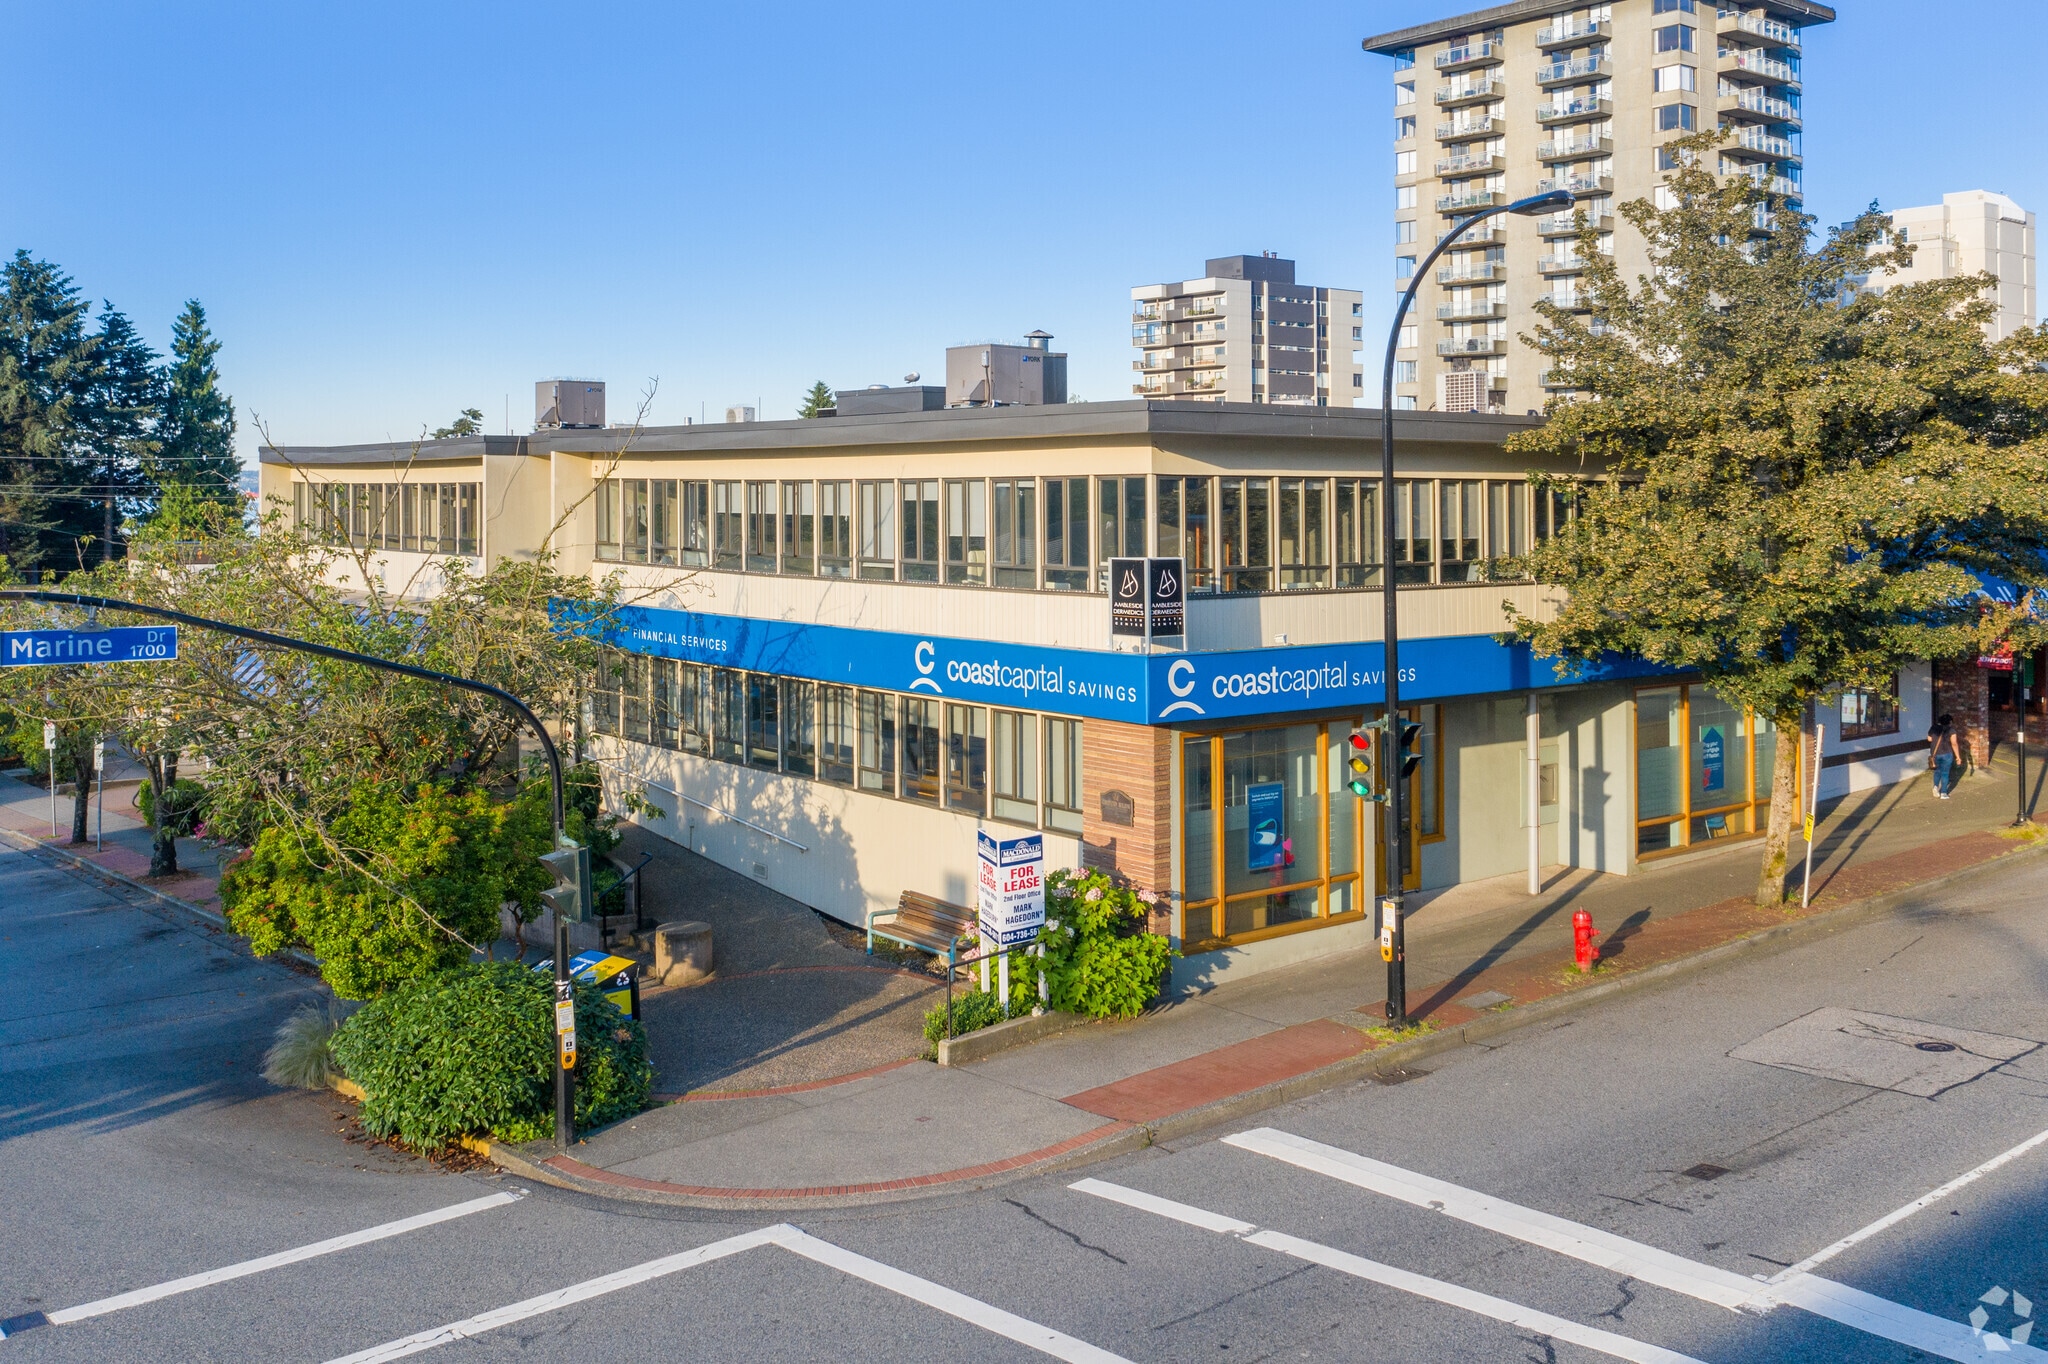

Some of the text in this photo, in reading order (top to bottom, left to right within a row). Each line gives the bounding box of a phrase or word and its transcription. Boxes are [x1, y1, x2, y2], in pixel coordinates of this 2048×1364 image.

[11, 631, 166, 659] Marine Dr
[633, 629, 727, 651] FINANCIAL SERVICES
[130, 644, 167, 657] 1700
[947, 660, 1137, 703] coastcapital SAVINGS
[1212, 661, 1416, 698] coastcapital SAVIGS
[1003, 845, 1041, 857] MACDONALD
[983, 862, 994, 879] FOR
[1010, 865, 1034, 879] FOR
[980, 872, 997, 891] LEASE
[1004, 876, 1040, 893] LEASE
[1014, 893, 1026, 901] Floor
[1027, 890, 1041, 898] Office
[1013, 902, 1033, 913] MARK
